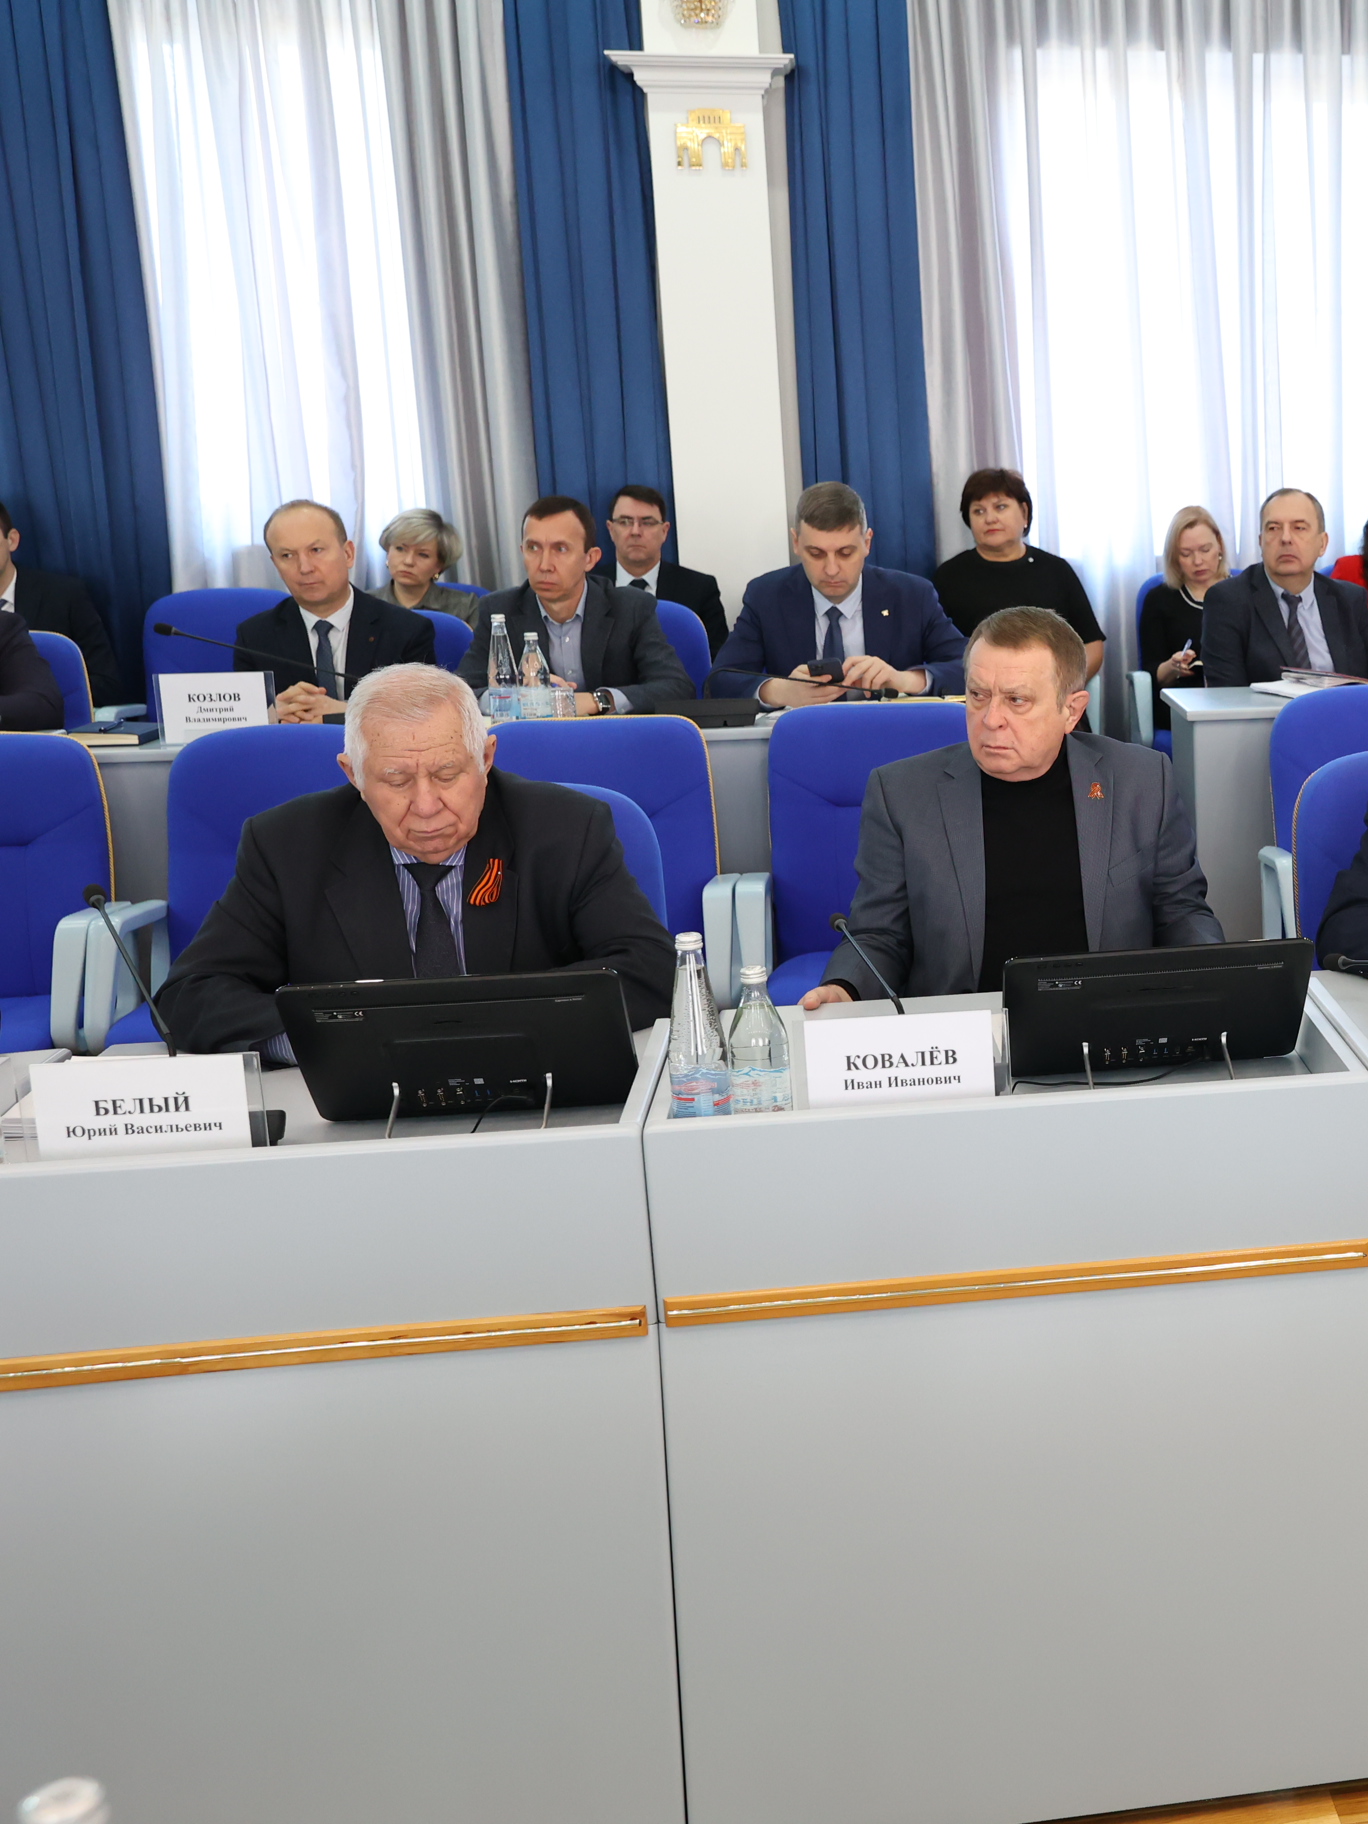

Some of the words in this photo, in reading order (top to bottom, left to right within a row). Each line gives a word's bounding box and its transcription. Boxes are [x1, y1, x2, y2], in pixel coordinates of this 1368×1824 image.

[187, 693, 241, 703] КОЗЛОВ
[196, 705, 235, 714] Дмитрий
[185, 715, 248, 724] Владимирович
[845, 1046, 958, 1072] КОВАЛЁВ
[844, 1078, 883, 1091] Иван
[887, 1074, 962, 1088] Иванович
[93, 1091, 192, 1117] БЕЛЫЙ
[65, 1123, 119, 1141] Юрий
[124, 1121, 223, 1136] Васильевич
